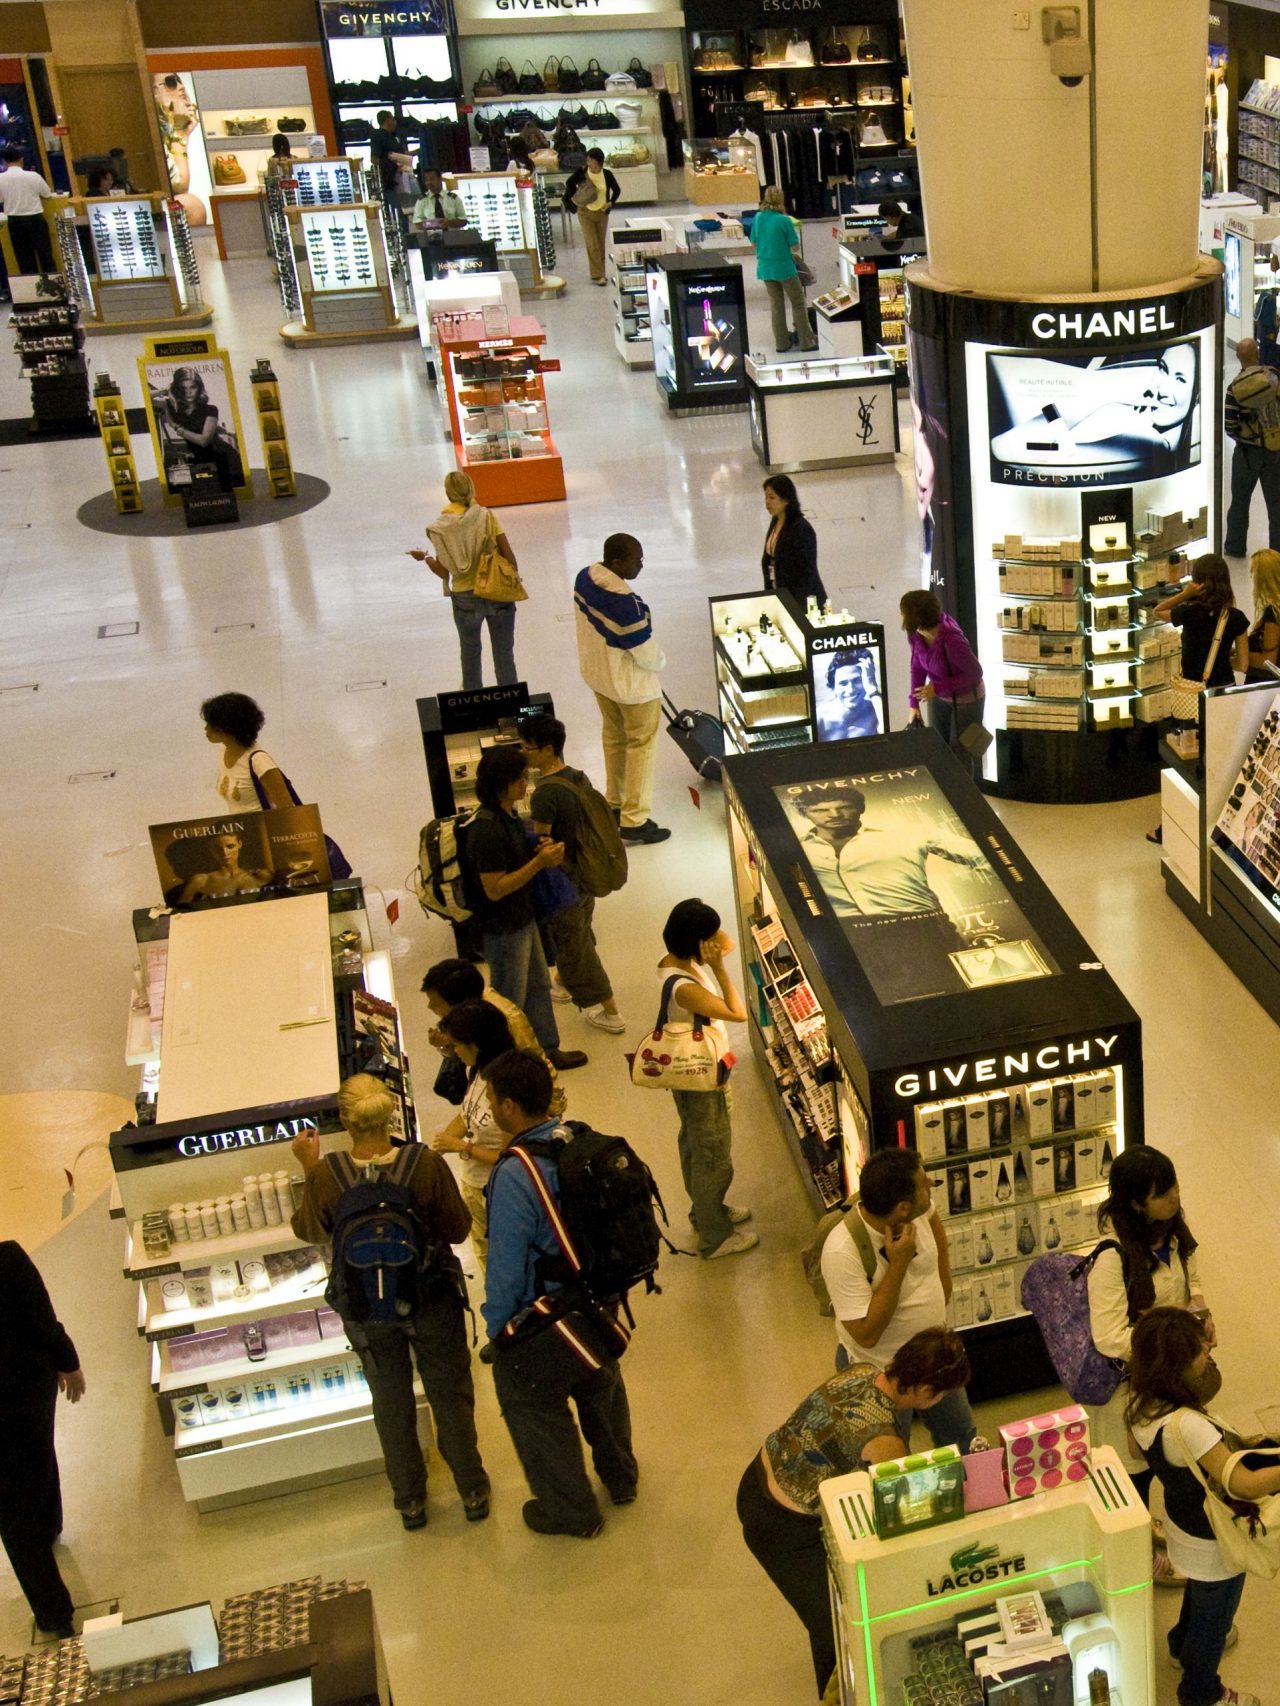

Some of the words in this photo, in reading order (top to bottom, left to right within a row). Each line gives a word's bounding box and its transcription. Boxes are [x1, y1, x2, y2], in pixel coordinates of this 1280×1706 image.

[763, 0, 822, 11] ESCADA
[339, 12, 432, 25] GIVENCHY
[1032, 305, 1175, 339] CHANEL
[1003, 467, 1105, 482] PRÉCISION
[1098, 514, 1117, 523] NEW
[812, 632, 878, 651] CHANEL
[448, 690, 521, 706] GIVENCHY
[787, 769, 918, 794] GIVENCHY
[892, 793, 931, 806] NEW
[173, 821, 245, 840] GUERLAIN
[272, 831, 319, 844] TERRACOTTA
[962, 926, 1000, 936] neo
[894, 1035, 1119, 1097] GIVENCHY
[178, 1116, 319, 1157] GUERLAIN
[926, 1556, 1026, 1597] LACOSTE
